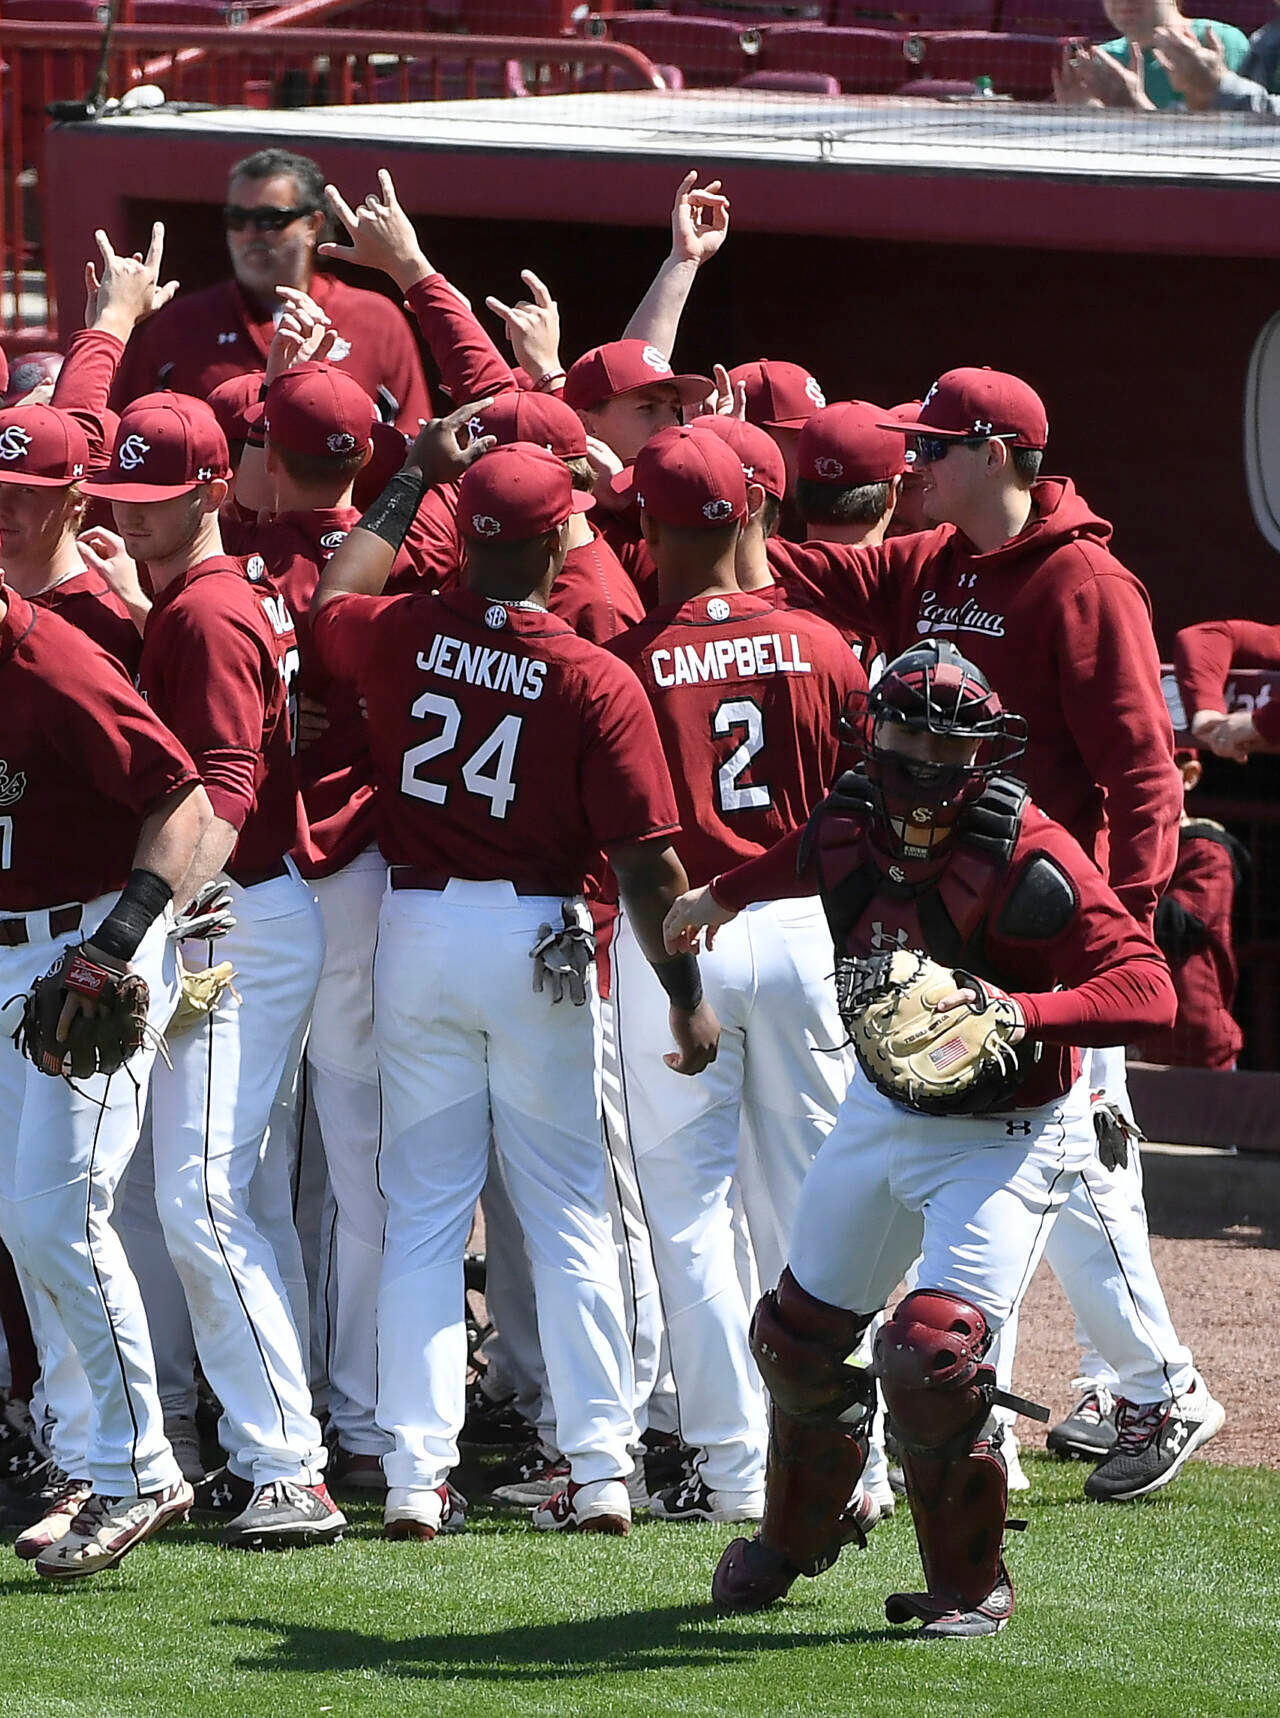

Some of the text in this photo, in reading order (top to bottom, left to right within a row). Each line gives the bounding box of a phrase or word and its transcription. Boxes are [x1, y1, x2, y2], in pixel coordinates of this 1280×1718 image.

[485, 605, 507, 628] SEC
[416, 633, 548, 700] JENKINS
[651, 633, 811, 688] CAMPBELL
[401, 691, 523, 819] 24
[714, 699, 766, 812] 2
